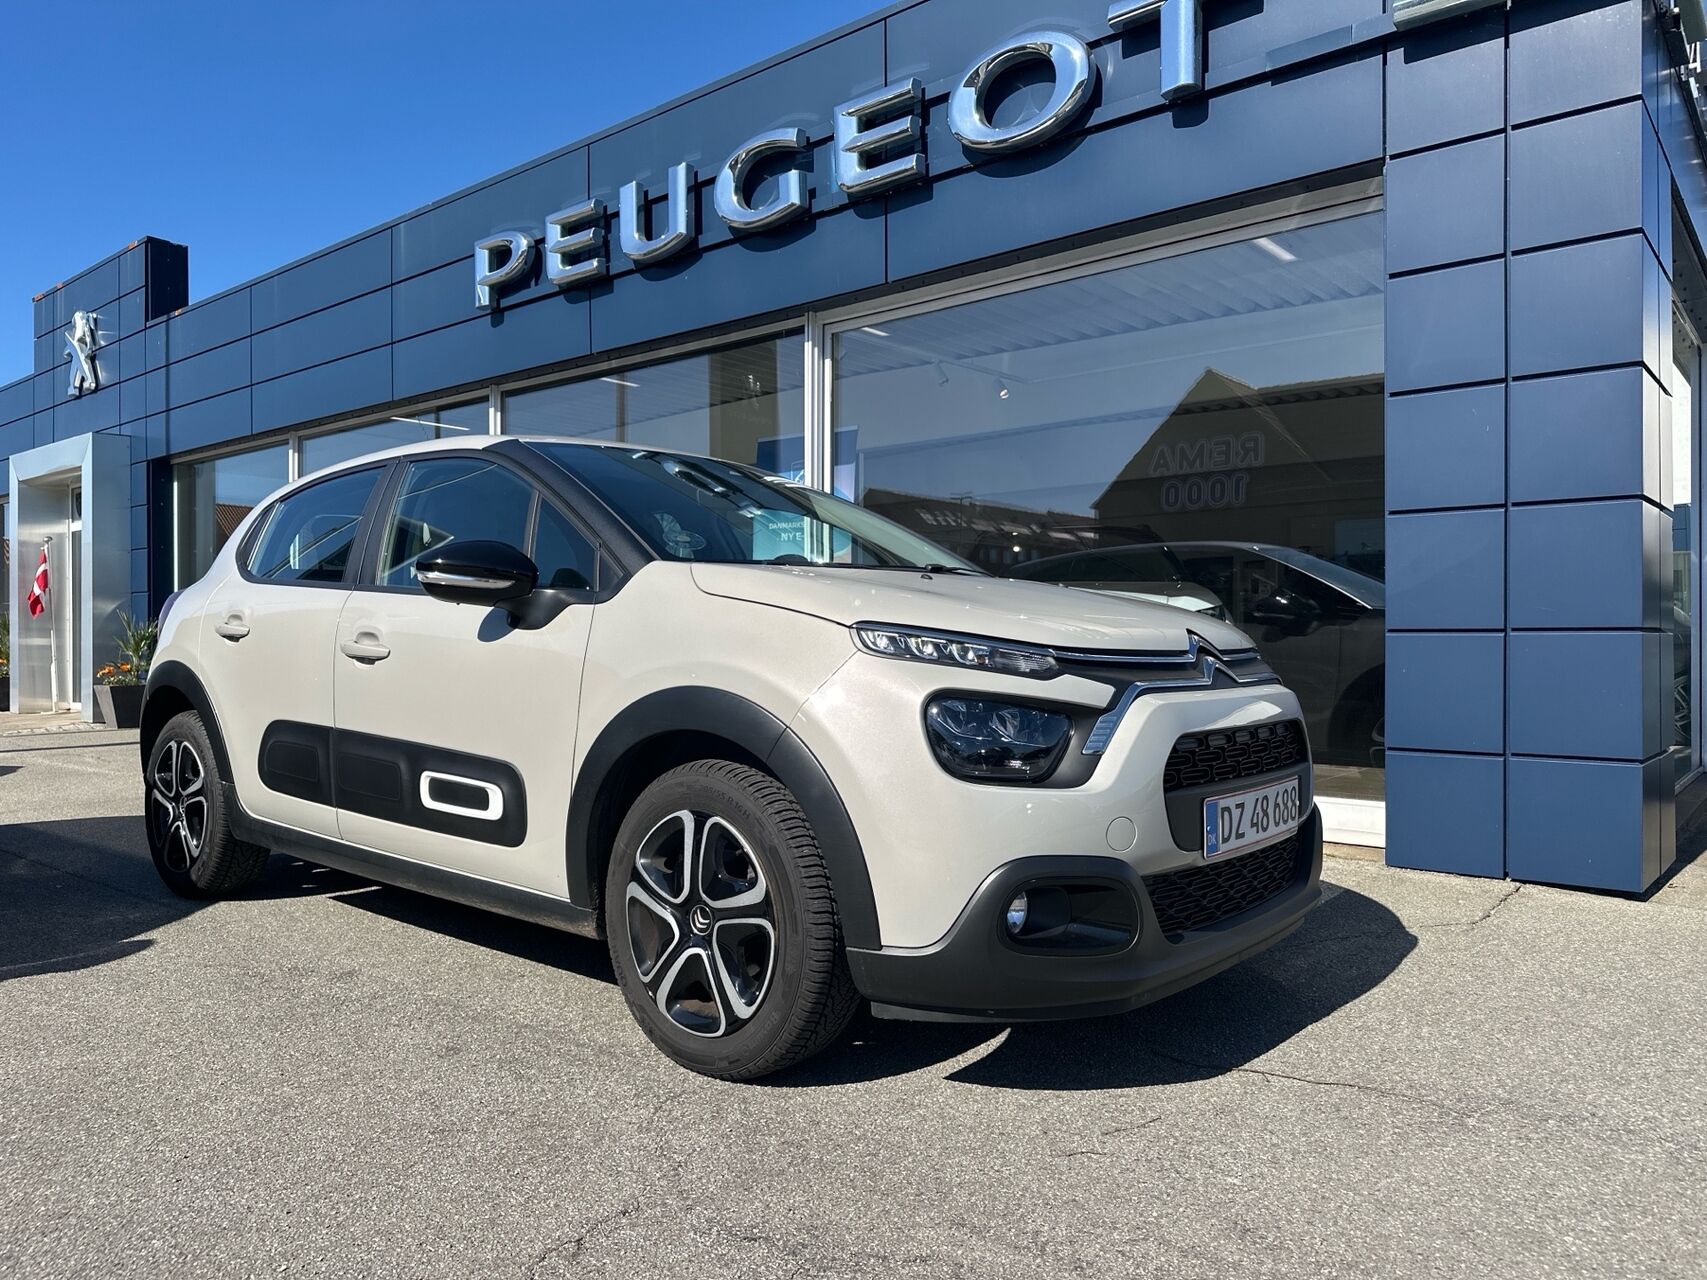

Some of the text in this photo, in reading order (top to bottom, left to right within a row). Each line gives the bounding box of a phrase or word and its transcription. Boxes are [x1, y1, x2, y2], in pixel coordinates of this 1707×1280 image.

[474, 0, 1202, 311] PEUGEOT
[1207, 833, 1217, 845] DK
[1220, 786, 1297, 844] DZ 48 688
